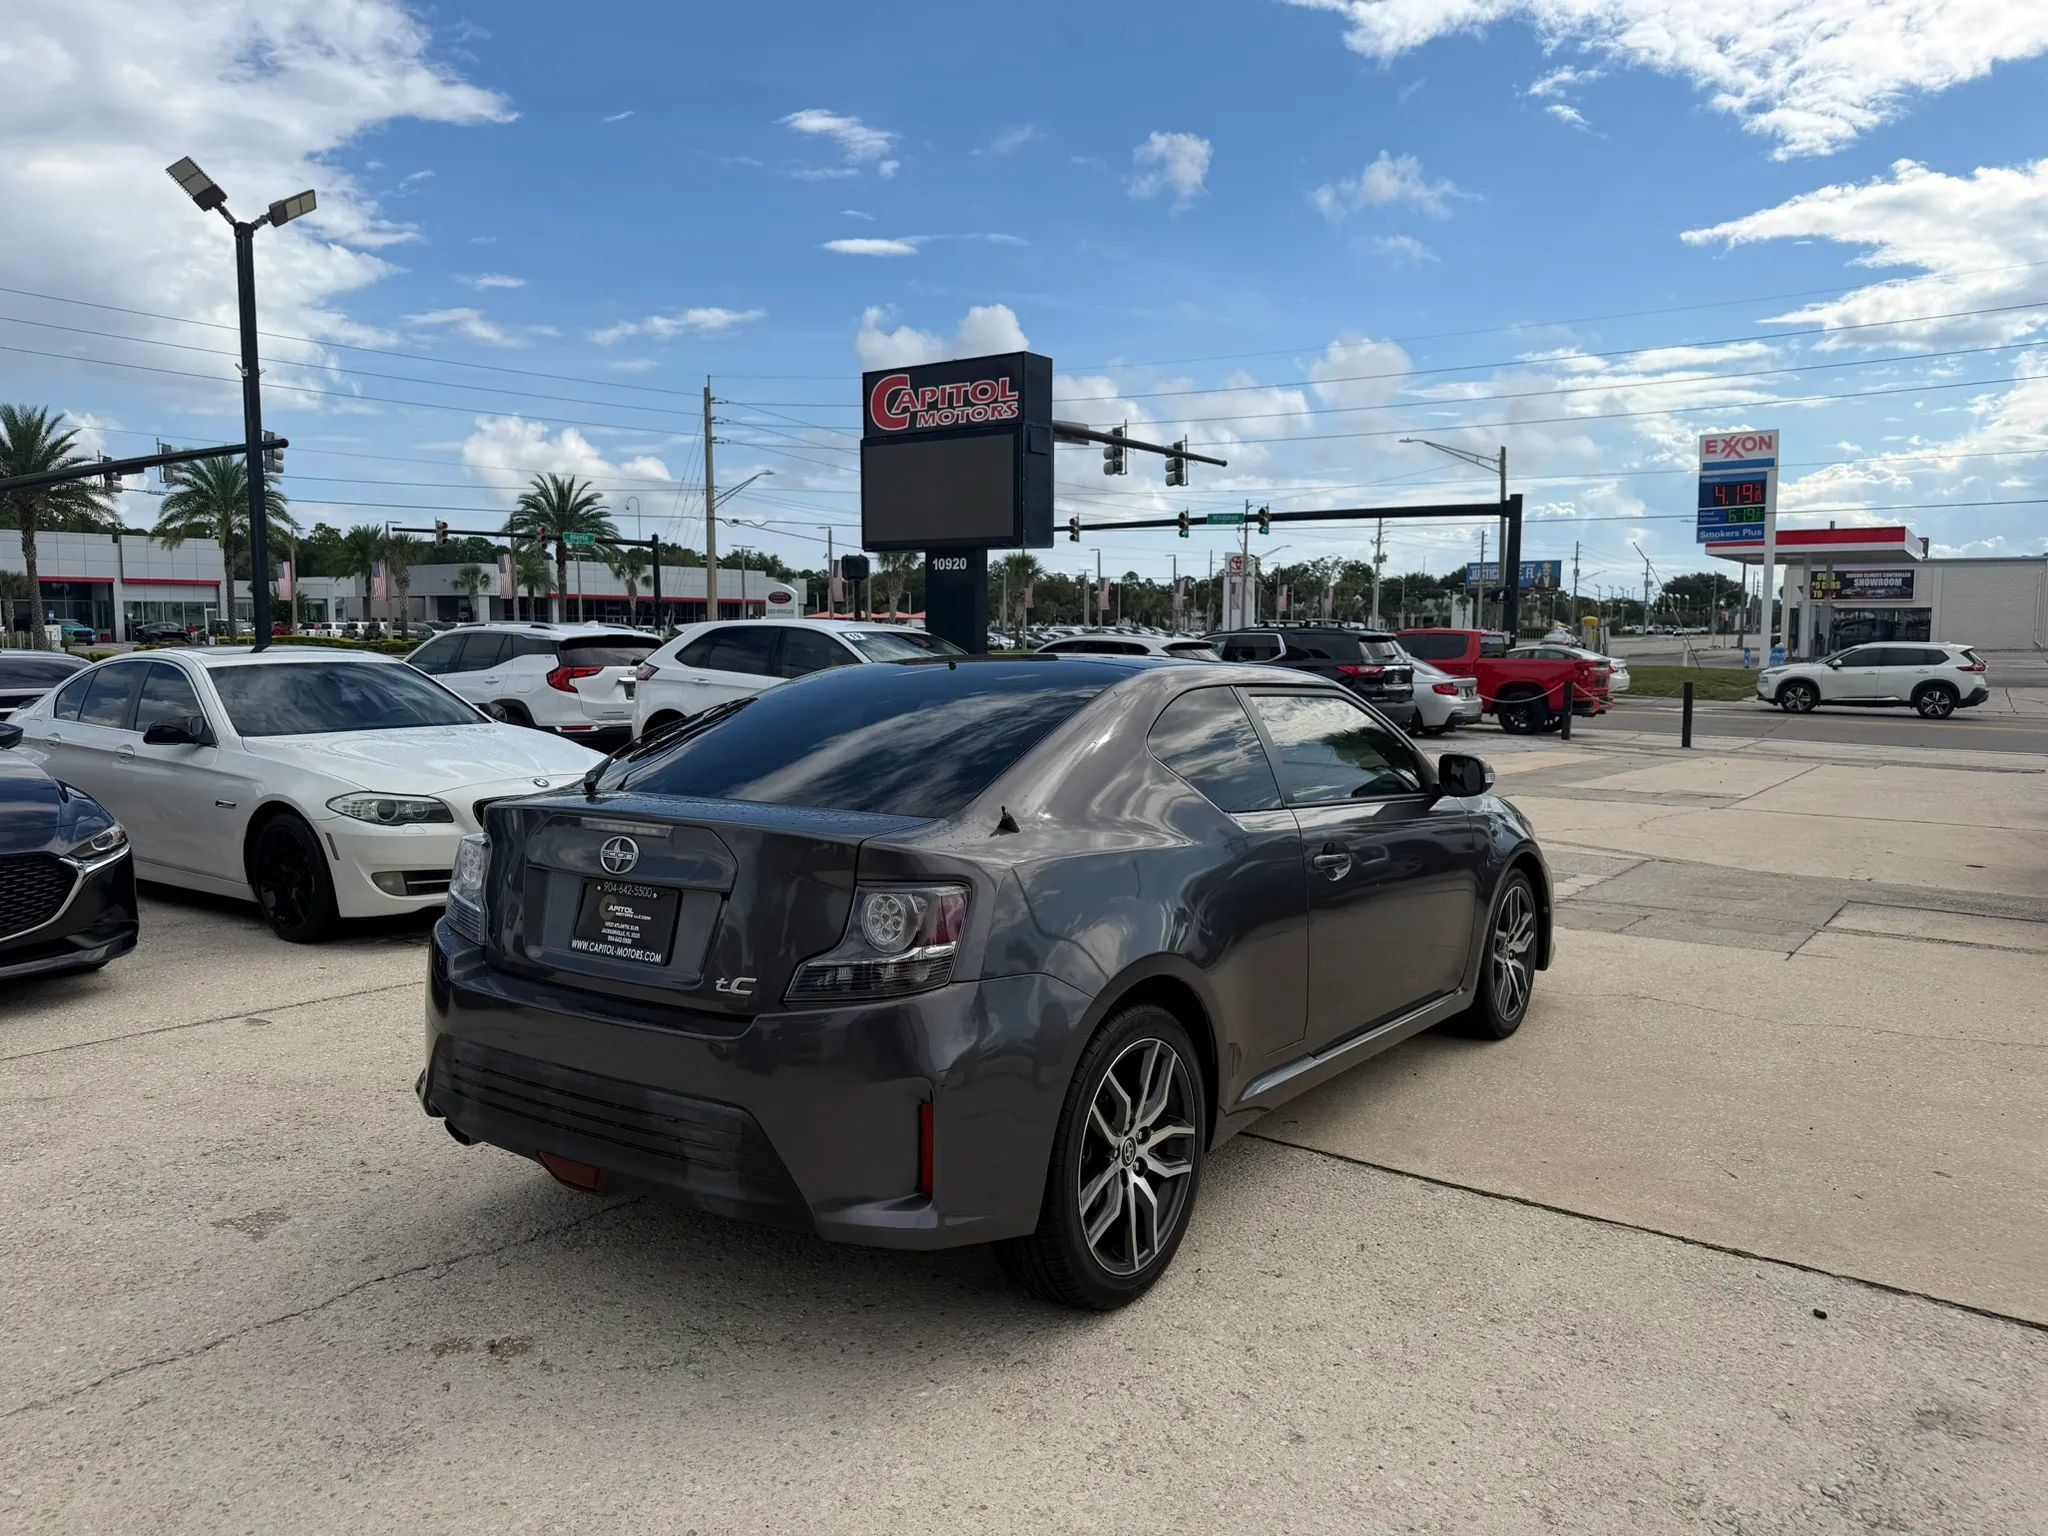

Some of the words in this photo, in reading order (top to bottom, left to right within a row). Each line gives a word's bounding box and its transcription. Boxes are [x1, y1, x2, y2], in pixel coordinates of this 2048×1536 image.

[870, 374, 1020, 431] CAPITOL
[916, 401, 1020, 428] MOTORS
[1704, 435, 1773, 458] EXXON
[1700, 529, 1740, 539] Smokers
[1742, 528, 1762, 537] Plus
[932, 557, 967, 571] 10920
[1817, 572, 1836, 581] OVR
[1853, 578, 1902, 587] SHOWROOM
[1821, 581, 1841, 589] CRS
[1813, 590, 1823, 598] TO
[603, 882, 653, 898] 904-642-5500
[571, 938, 662, 963] WWW.CAPITOL-MOTORS.COM
[715, 977, 758, 996] tC
